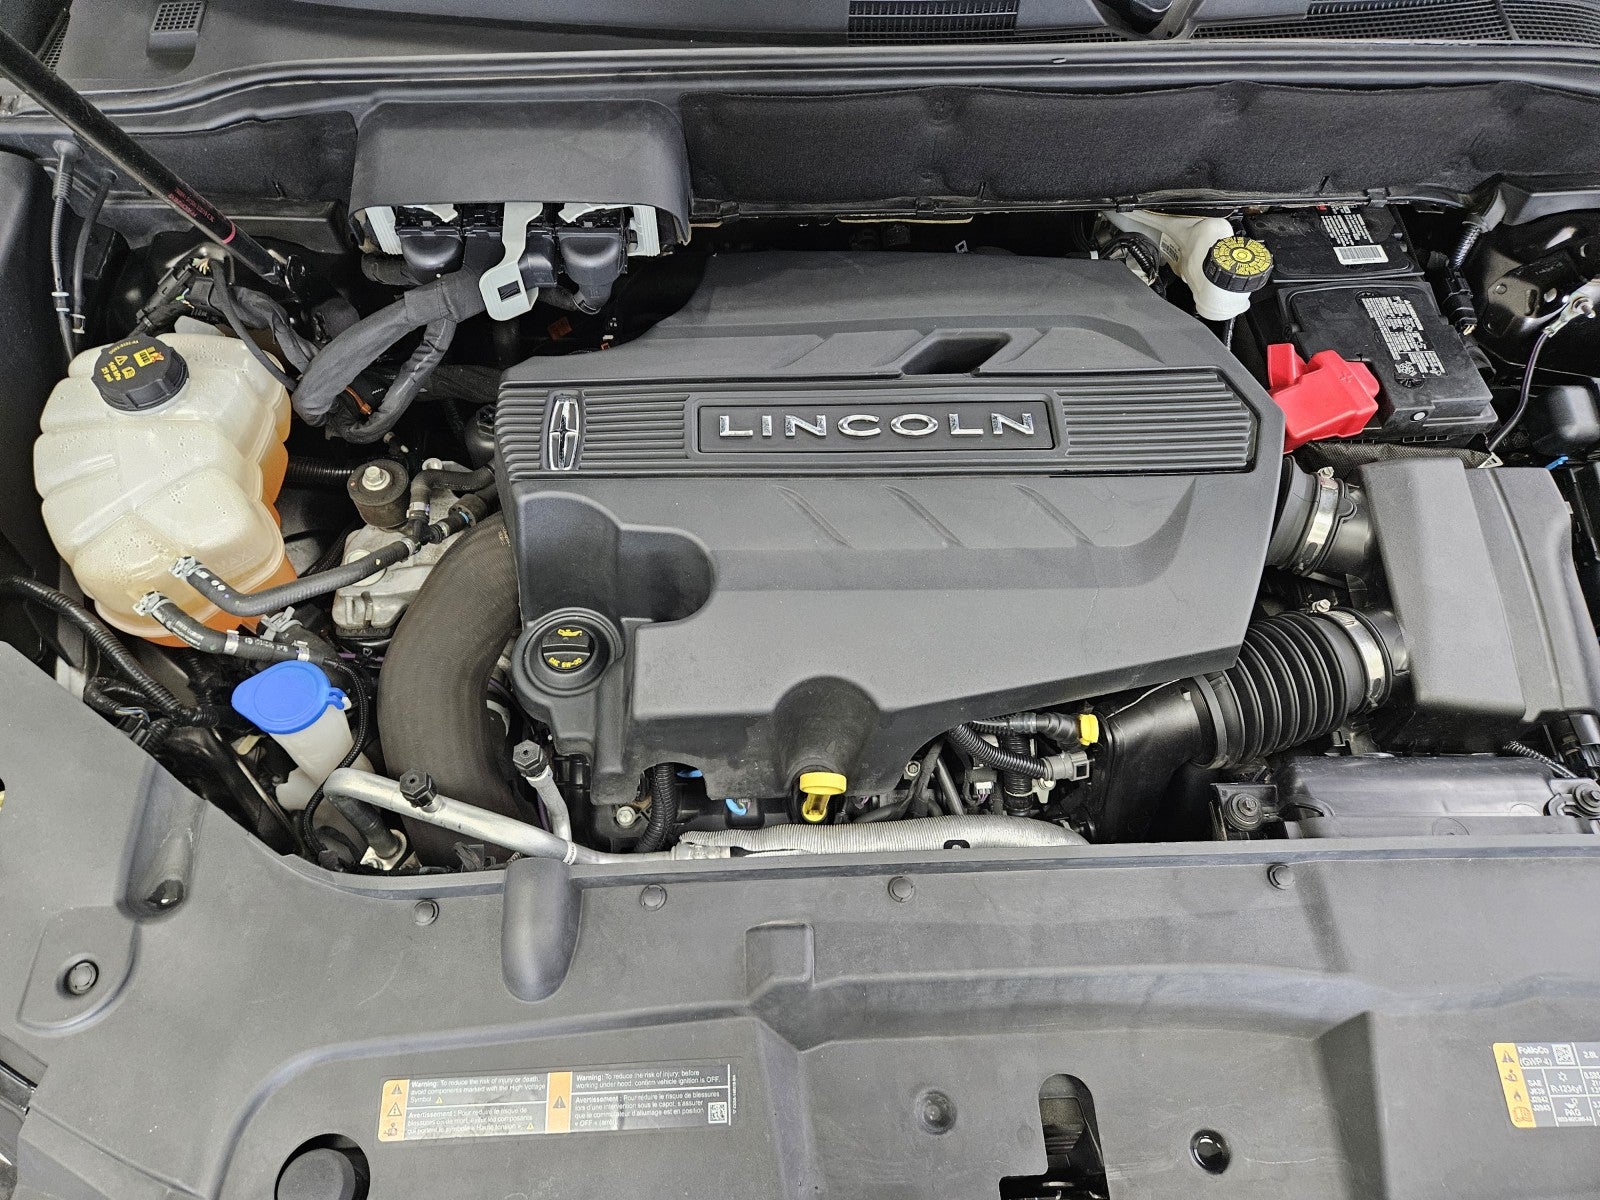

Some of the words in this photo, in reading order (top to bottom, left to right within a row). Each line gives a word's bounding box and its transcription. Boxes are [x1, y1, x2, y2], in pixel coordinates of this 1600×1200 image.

[719, 413, 1034, 437] LINCOLN
[1517, 1046, 1549, 1054] FoMoCo
[498, 1076, 514, 1086] injury
[576, 1082, 598, 1090] working
[635, 1079, 656, 1087] confirm
[678, 1077, 698, 1086] ignition
[428, 1086, 462, 1096] components
[510, 1084, 522, 1092] High
[524, 1082, 546, 1092] Voltage
[576, 1096, 618, 1104] Avertissement
[666, 1092, 682, 1100] risque
[692, 1090, 720, 1098] blessures
[408, 1110, 453, 1119] Avertissement
[682, 1107, 704, 1115] position
